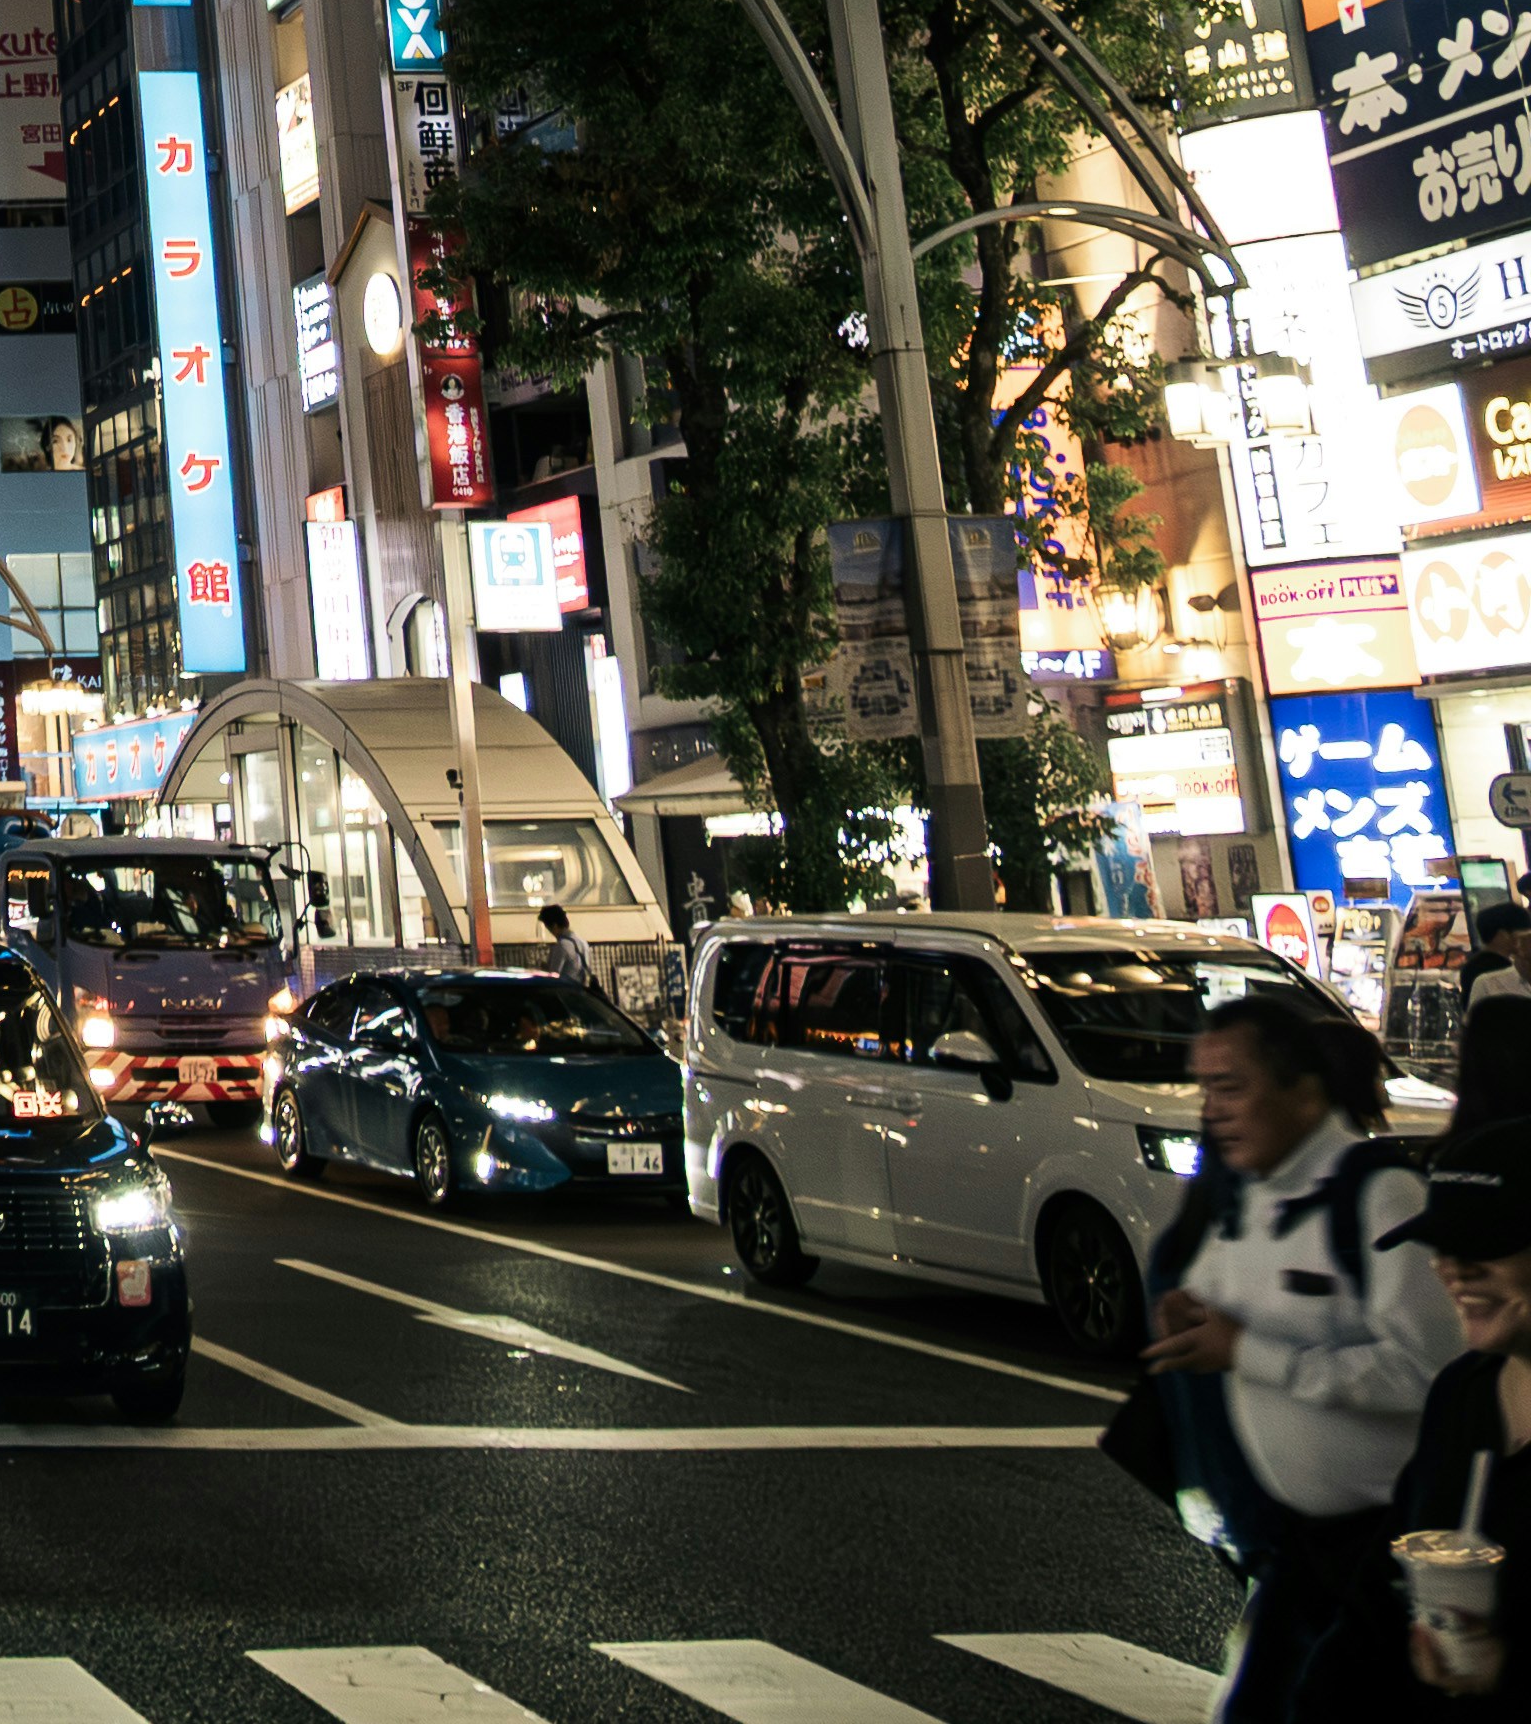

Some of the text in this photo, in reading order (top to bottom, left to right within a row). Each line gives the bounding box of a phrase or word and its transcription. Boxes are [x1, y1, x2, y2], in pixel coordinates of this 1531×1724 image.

[397, 81, 414, 93] 3F
[2, 286, 32, 326] 占
[154, 135, 232, 606] カラオケ館
[444, 402, 471, 486] 香港飯店
[1279, 722, 1432, 778] ゲーム
[1292, 780, 1434, 839] メンズ
[13, 1090, 64, 1118] 回送
